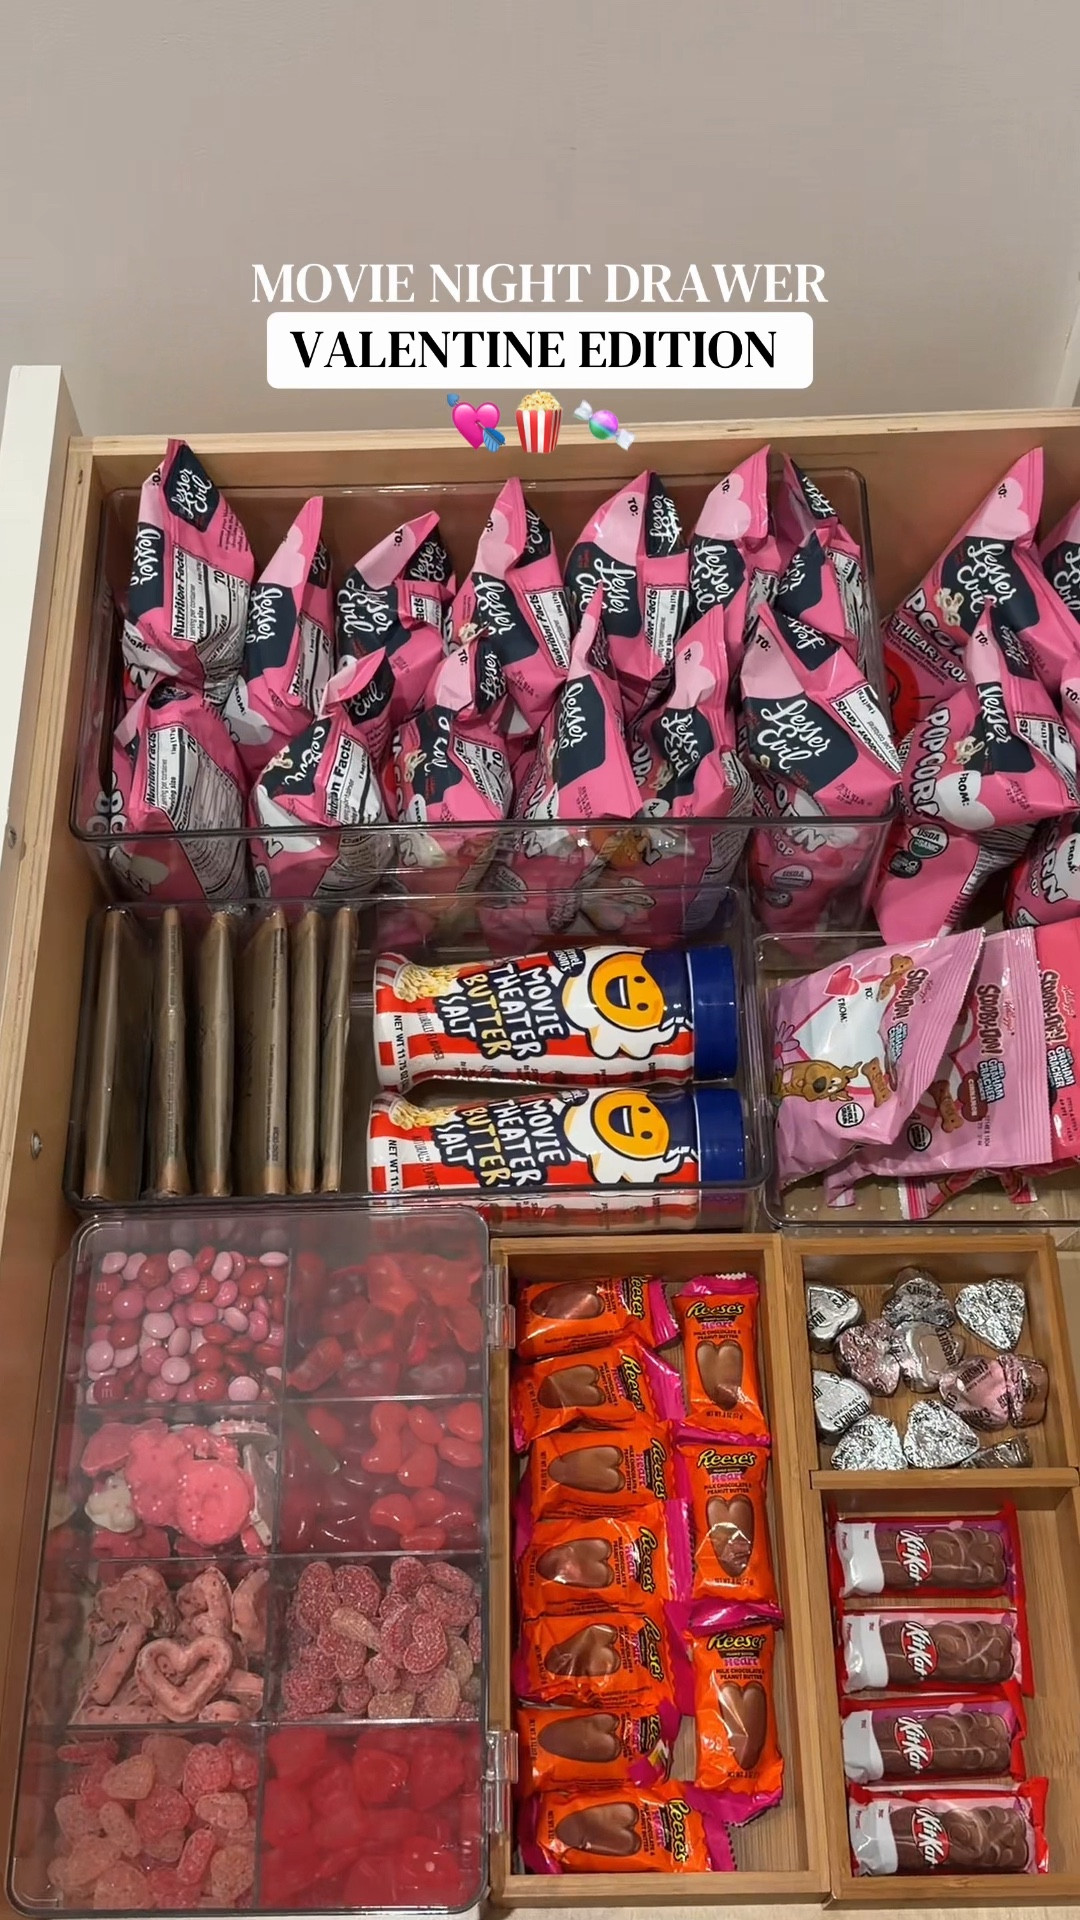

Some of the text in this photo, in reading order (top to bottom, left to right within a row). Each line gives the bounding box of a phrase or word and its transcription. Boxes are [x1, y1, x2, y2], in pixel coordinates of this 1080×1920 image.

[171, 468, 193, 520] Lesser
[627, 496, 638, 517] TO:
[721, 478, 731, 494] TO:
[998, 482, 1008, 499] TO:
[135, 527, 161, 586] Lesser
[394, 529, 403, 547] TO:
[213, 571, 226, 585] 70
[594, 558, 637, 613] Lesser
[694, 539, 734, 603] Lesser
[967, 540, 1017, 605] Lesser
[173, 550, 186, 638] Nutrition Facts
[251, 586, 283, 643] Lesser
[337, 587, 374, 638] Evil
[474, 575, 517, 635] Lesser
[647, 589, 658, 613] Facts
[457, 649, 468, 666] TO:
[755, 634, 772, 652] TO:
[974, 629, 989, 647] TO:
[480, 653, 498, 700] Lesser
[354, 681, 386, 716] Evil
[564, 683, 589, 748] Lesser
[978, 686, 1013, 744] Lesser
[147, 732, 157, 761] Facts
[187, 735, 197, 753] 70
[757, 727, 813, 772] Evil
[760, 700, 830, 757] Lesser
[337, 738, 352, 778] Facts
[958, 772, 971, 807] FROM:
[917, 829, 941, 843] USDA
[463, 974, 512, 1056] BUTTER
[489, 962, 542, 1058] THEATER
[519, 967, 566, 1037] MOVIE
[837, 997, 848, 1023] FROM:
[864, 986, 873, 1001] TO:
[393, 1014, 403, 1032] NET
[438, 995, 477, 1038] SALT
[976, 984, 1003, 1055] SCOOBY-DOO!
[394, 1033, 405, 1048] WT
[979, 1060, 994, 1103] CRACKER
[988, 1058, 1004, 1099] GRAHAM
[1048, 1049, 1064, 1088] CRACKER
[1055, 1045, 1075, 1085] GRAHAM
[435, 1123, 476, 1167] SALT
[462, 1106, 512, 1186] BUTTER
[489, 1099, 542, 1187] THEATER
[519, 1099, 566, 1165] MOVIE
[388, 1139, 399, 1174] NET WT
[686, 1301, 745, 1318] Reese's
[621, 1353, 646, 1413] Reese's
[651, 1438, 668, 1500] Reese's
[697, 1449, 757, 1468] Reese's
[639, 1526, 657, 1593] Reese's
[642, 1616, 665, 1682] Reese's
[707, 1632, 766, 1651] Reese's
[669, 1797, 689, 1863] Reese's
